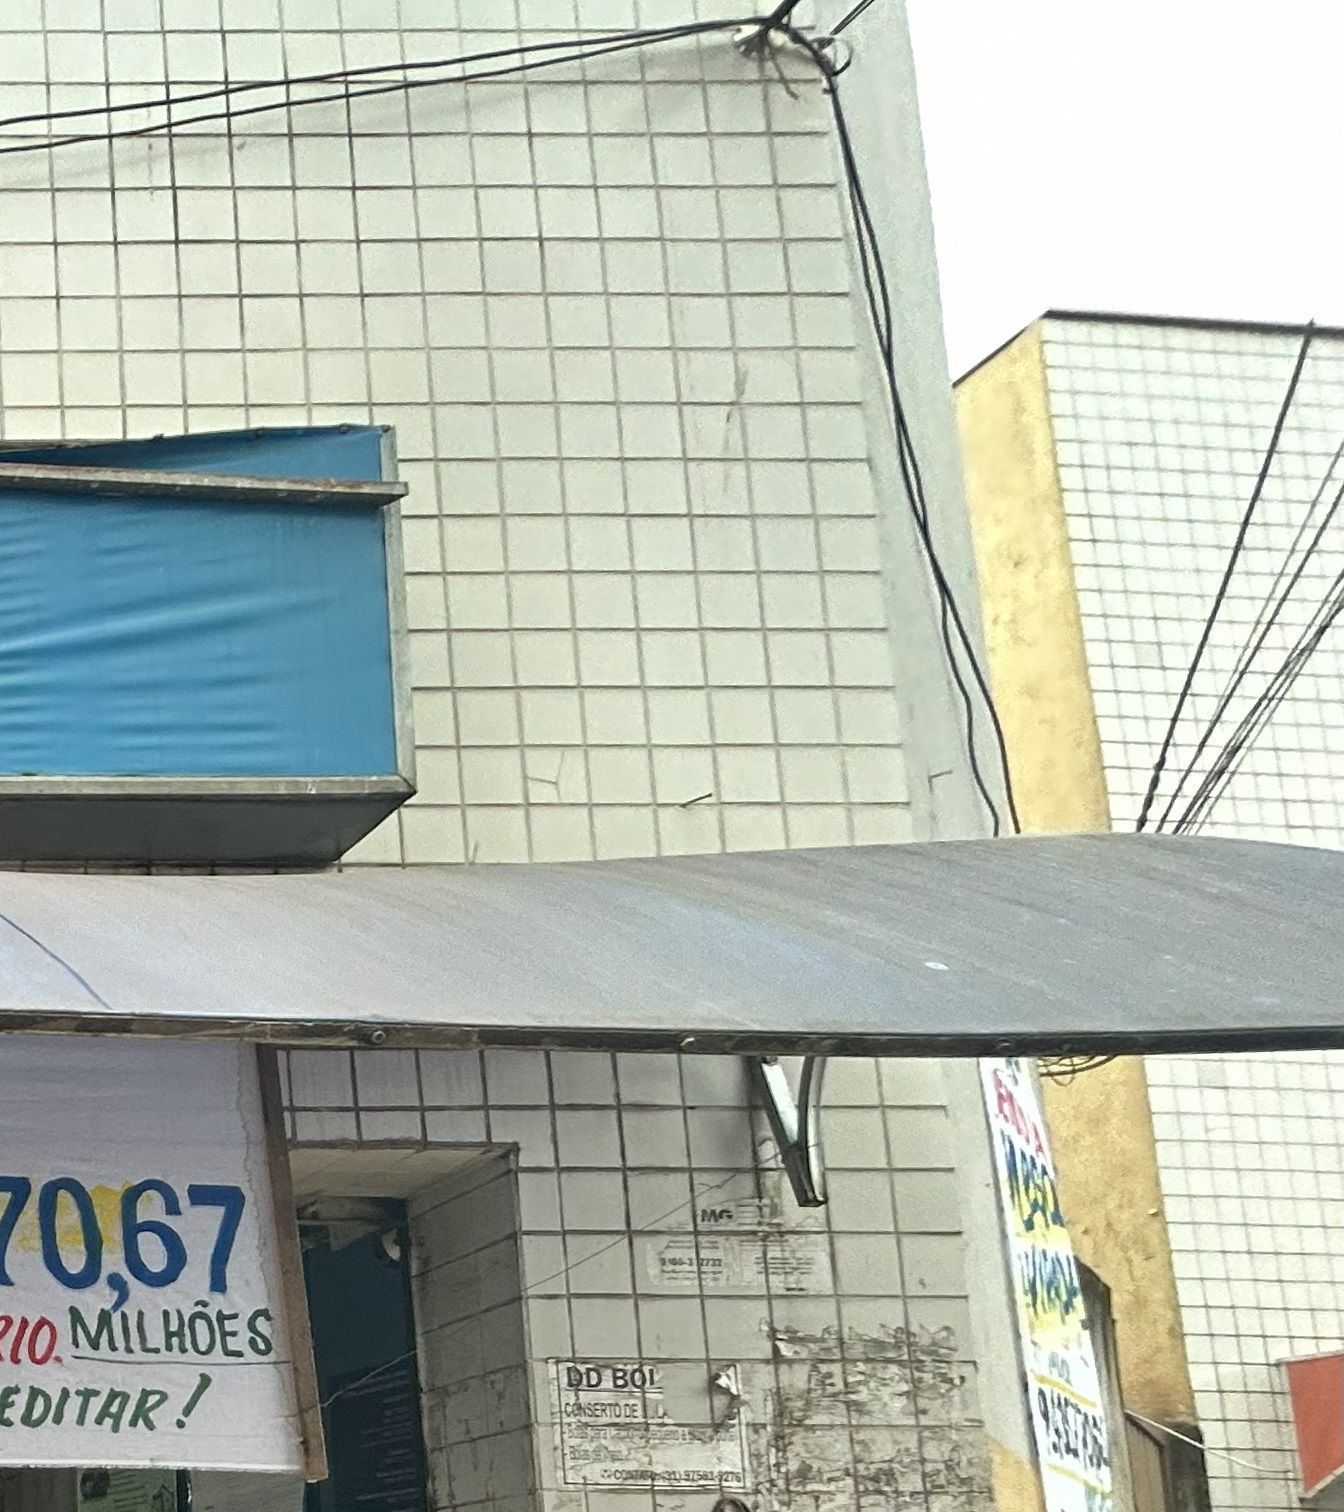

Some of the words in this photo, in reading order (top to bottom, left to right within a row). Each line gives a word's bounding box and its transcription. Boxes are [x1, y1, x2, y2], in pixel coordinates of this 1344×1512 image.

[68, 1300, 274, 1359] MILHÕES
[565, 1366, 602, 1388] DD
[624, 1403, 638, 1418] DE
